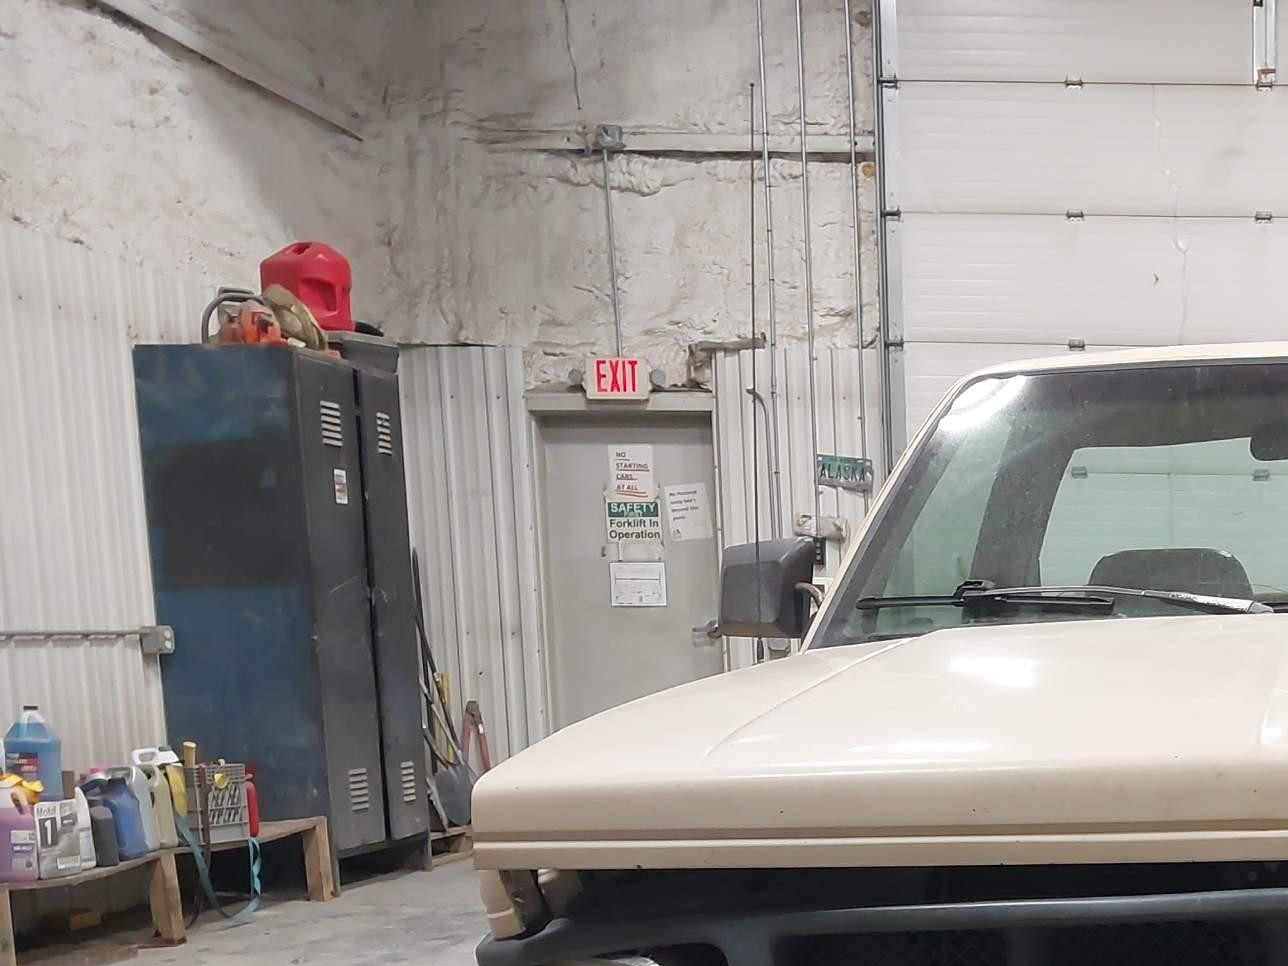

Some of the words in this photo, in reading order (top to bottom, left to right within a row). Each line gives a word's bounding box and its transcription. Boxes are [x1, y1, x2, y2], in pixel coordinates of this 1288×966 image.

[596, 360, 638, 392] EXIT
[820, 463, 866, 482] ALASKA
[610, 502, 656, 513] SAFETY
[610, 519, 647, 528] Forklift
[649, 519, 659, 528] In
[609, 530, 661, 541] Operation
[44, 818, 52, 846] 1
